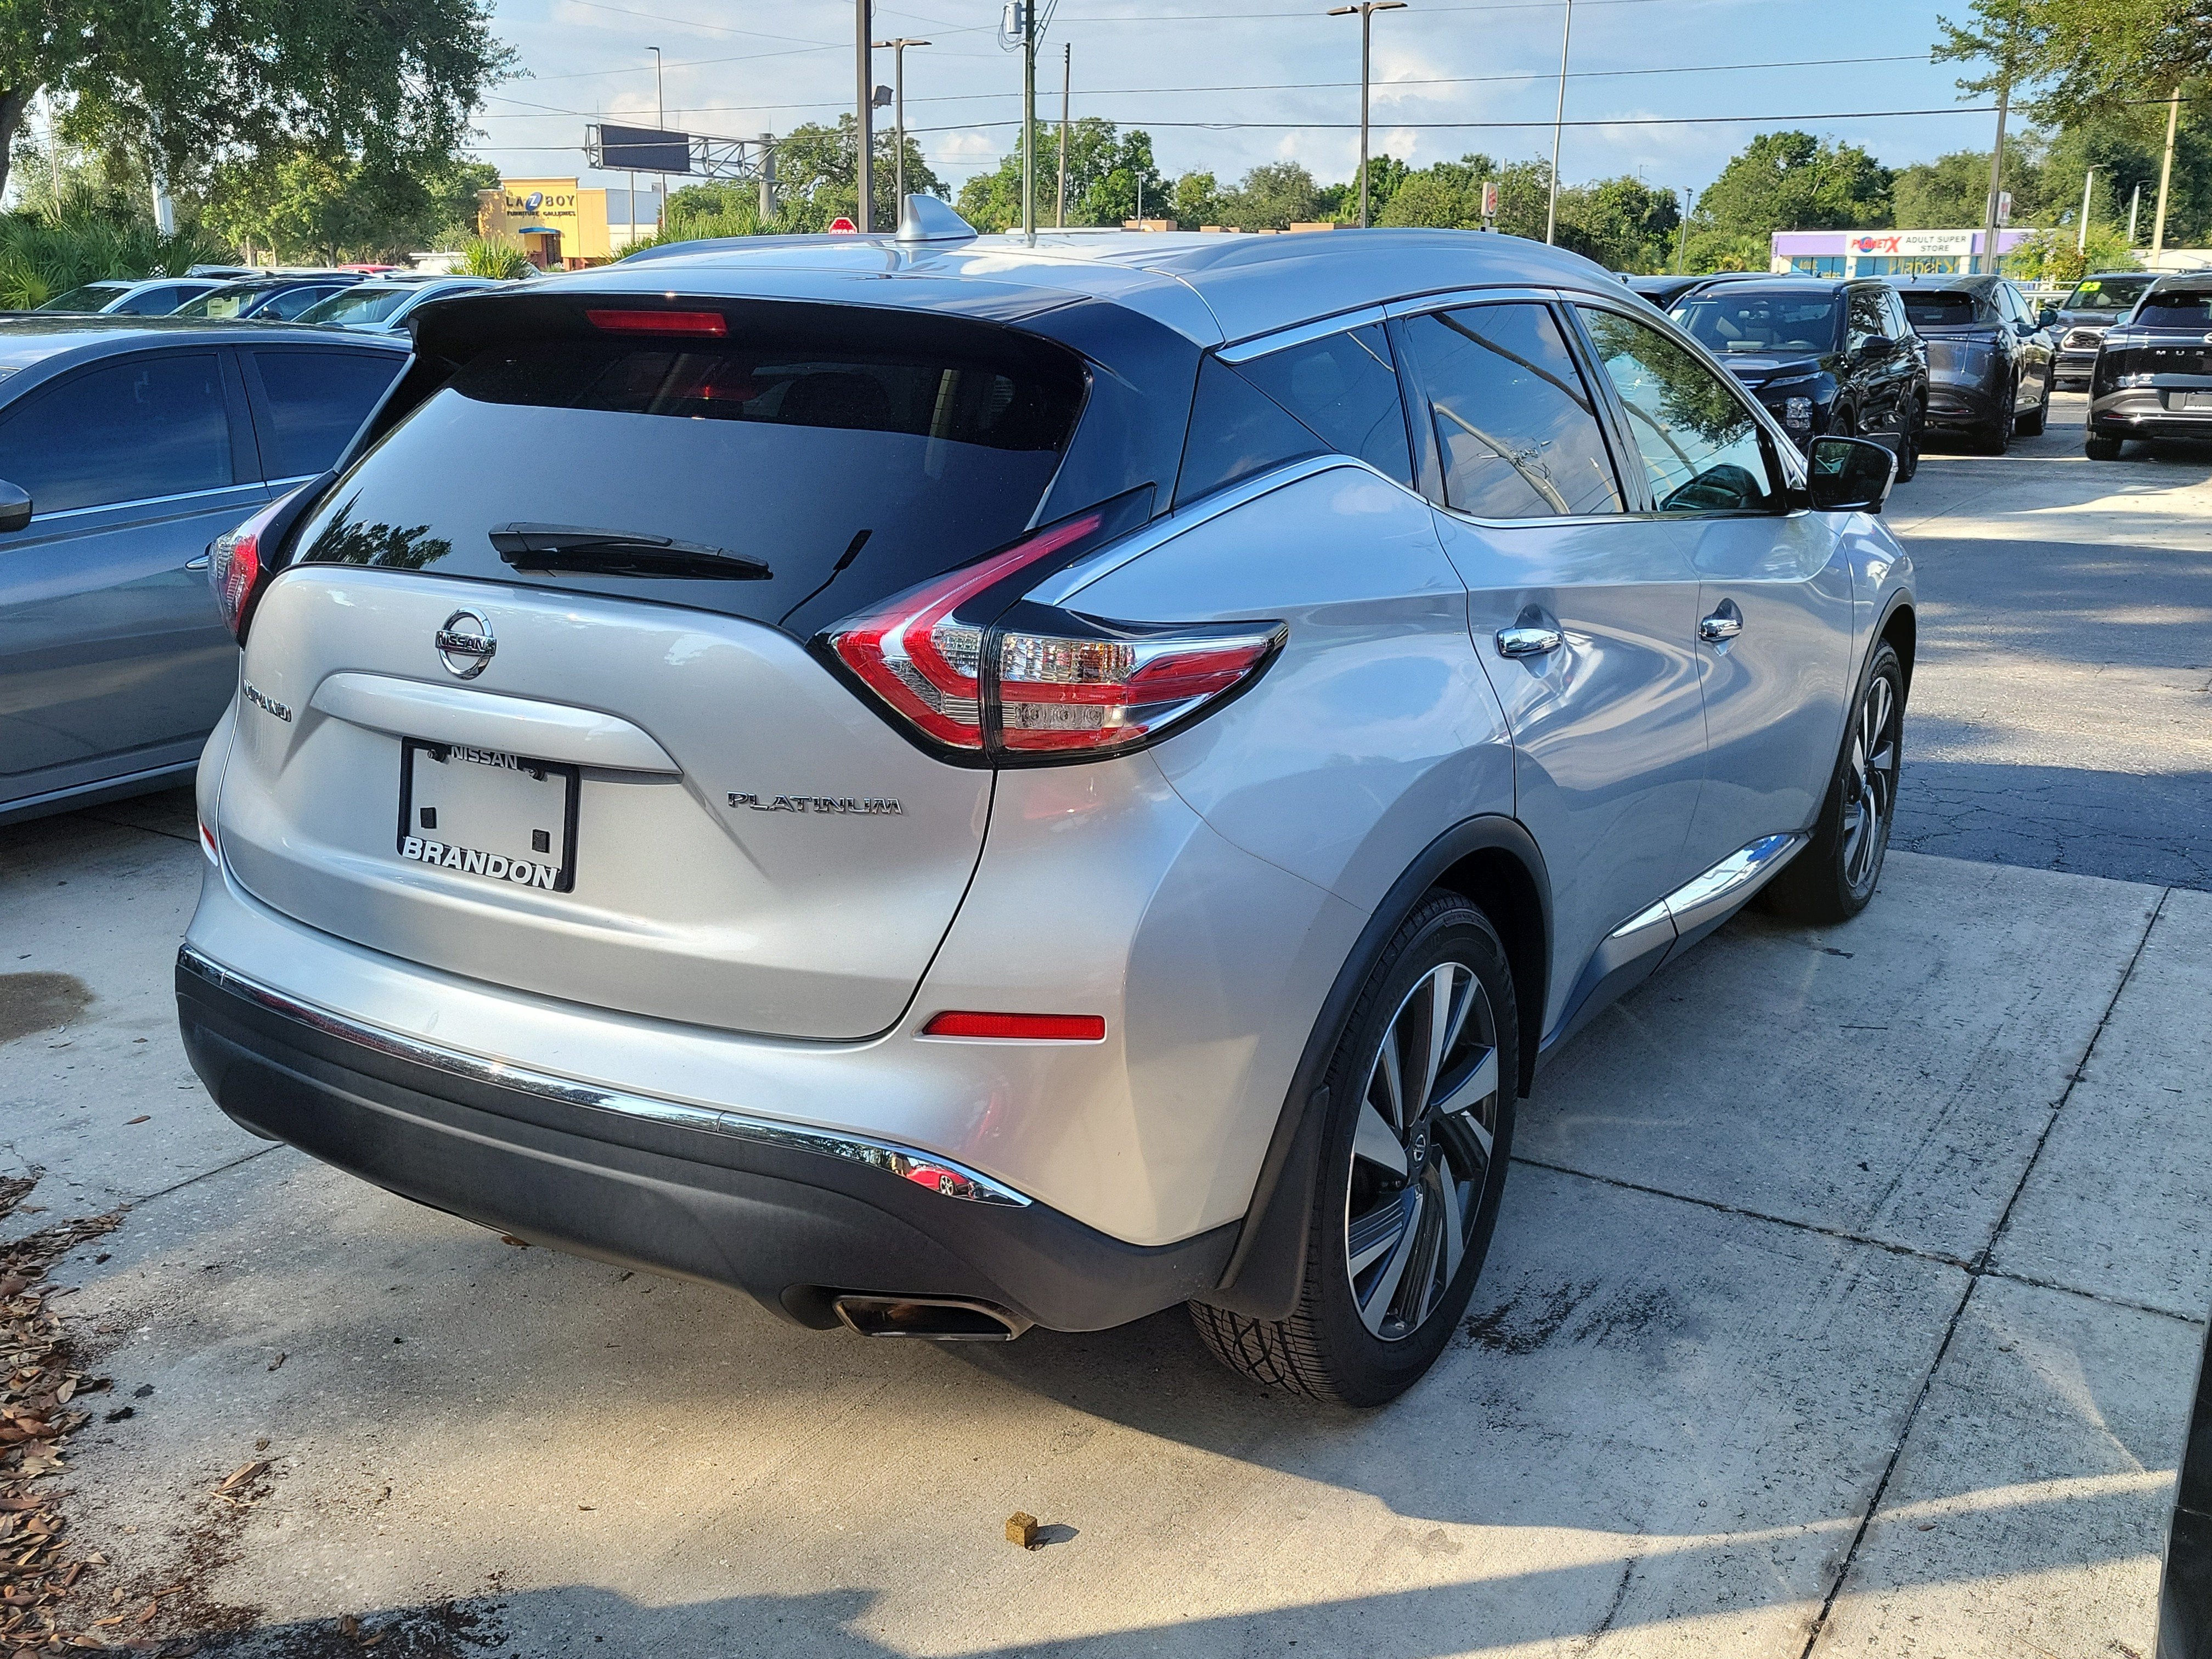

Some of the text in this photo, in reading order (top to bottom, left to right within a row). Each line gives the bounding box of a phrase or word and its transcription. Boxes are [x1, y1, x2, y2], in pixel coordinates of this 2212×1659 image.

[545, 195, 575, 207] BOY
[1851, 237, 1891, 250] PLANET
[2078, 281, 2102, 291] 23
[438, 631, 487, 653] NISSAN
[450, 746, 518, 770] NISSAN
[726, 791, 903, 815] PLATINUM
[402, 836, 558, 890] BRANDON
